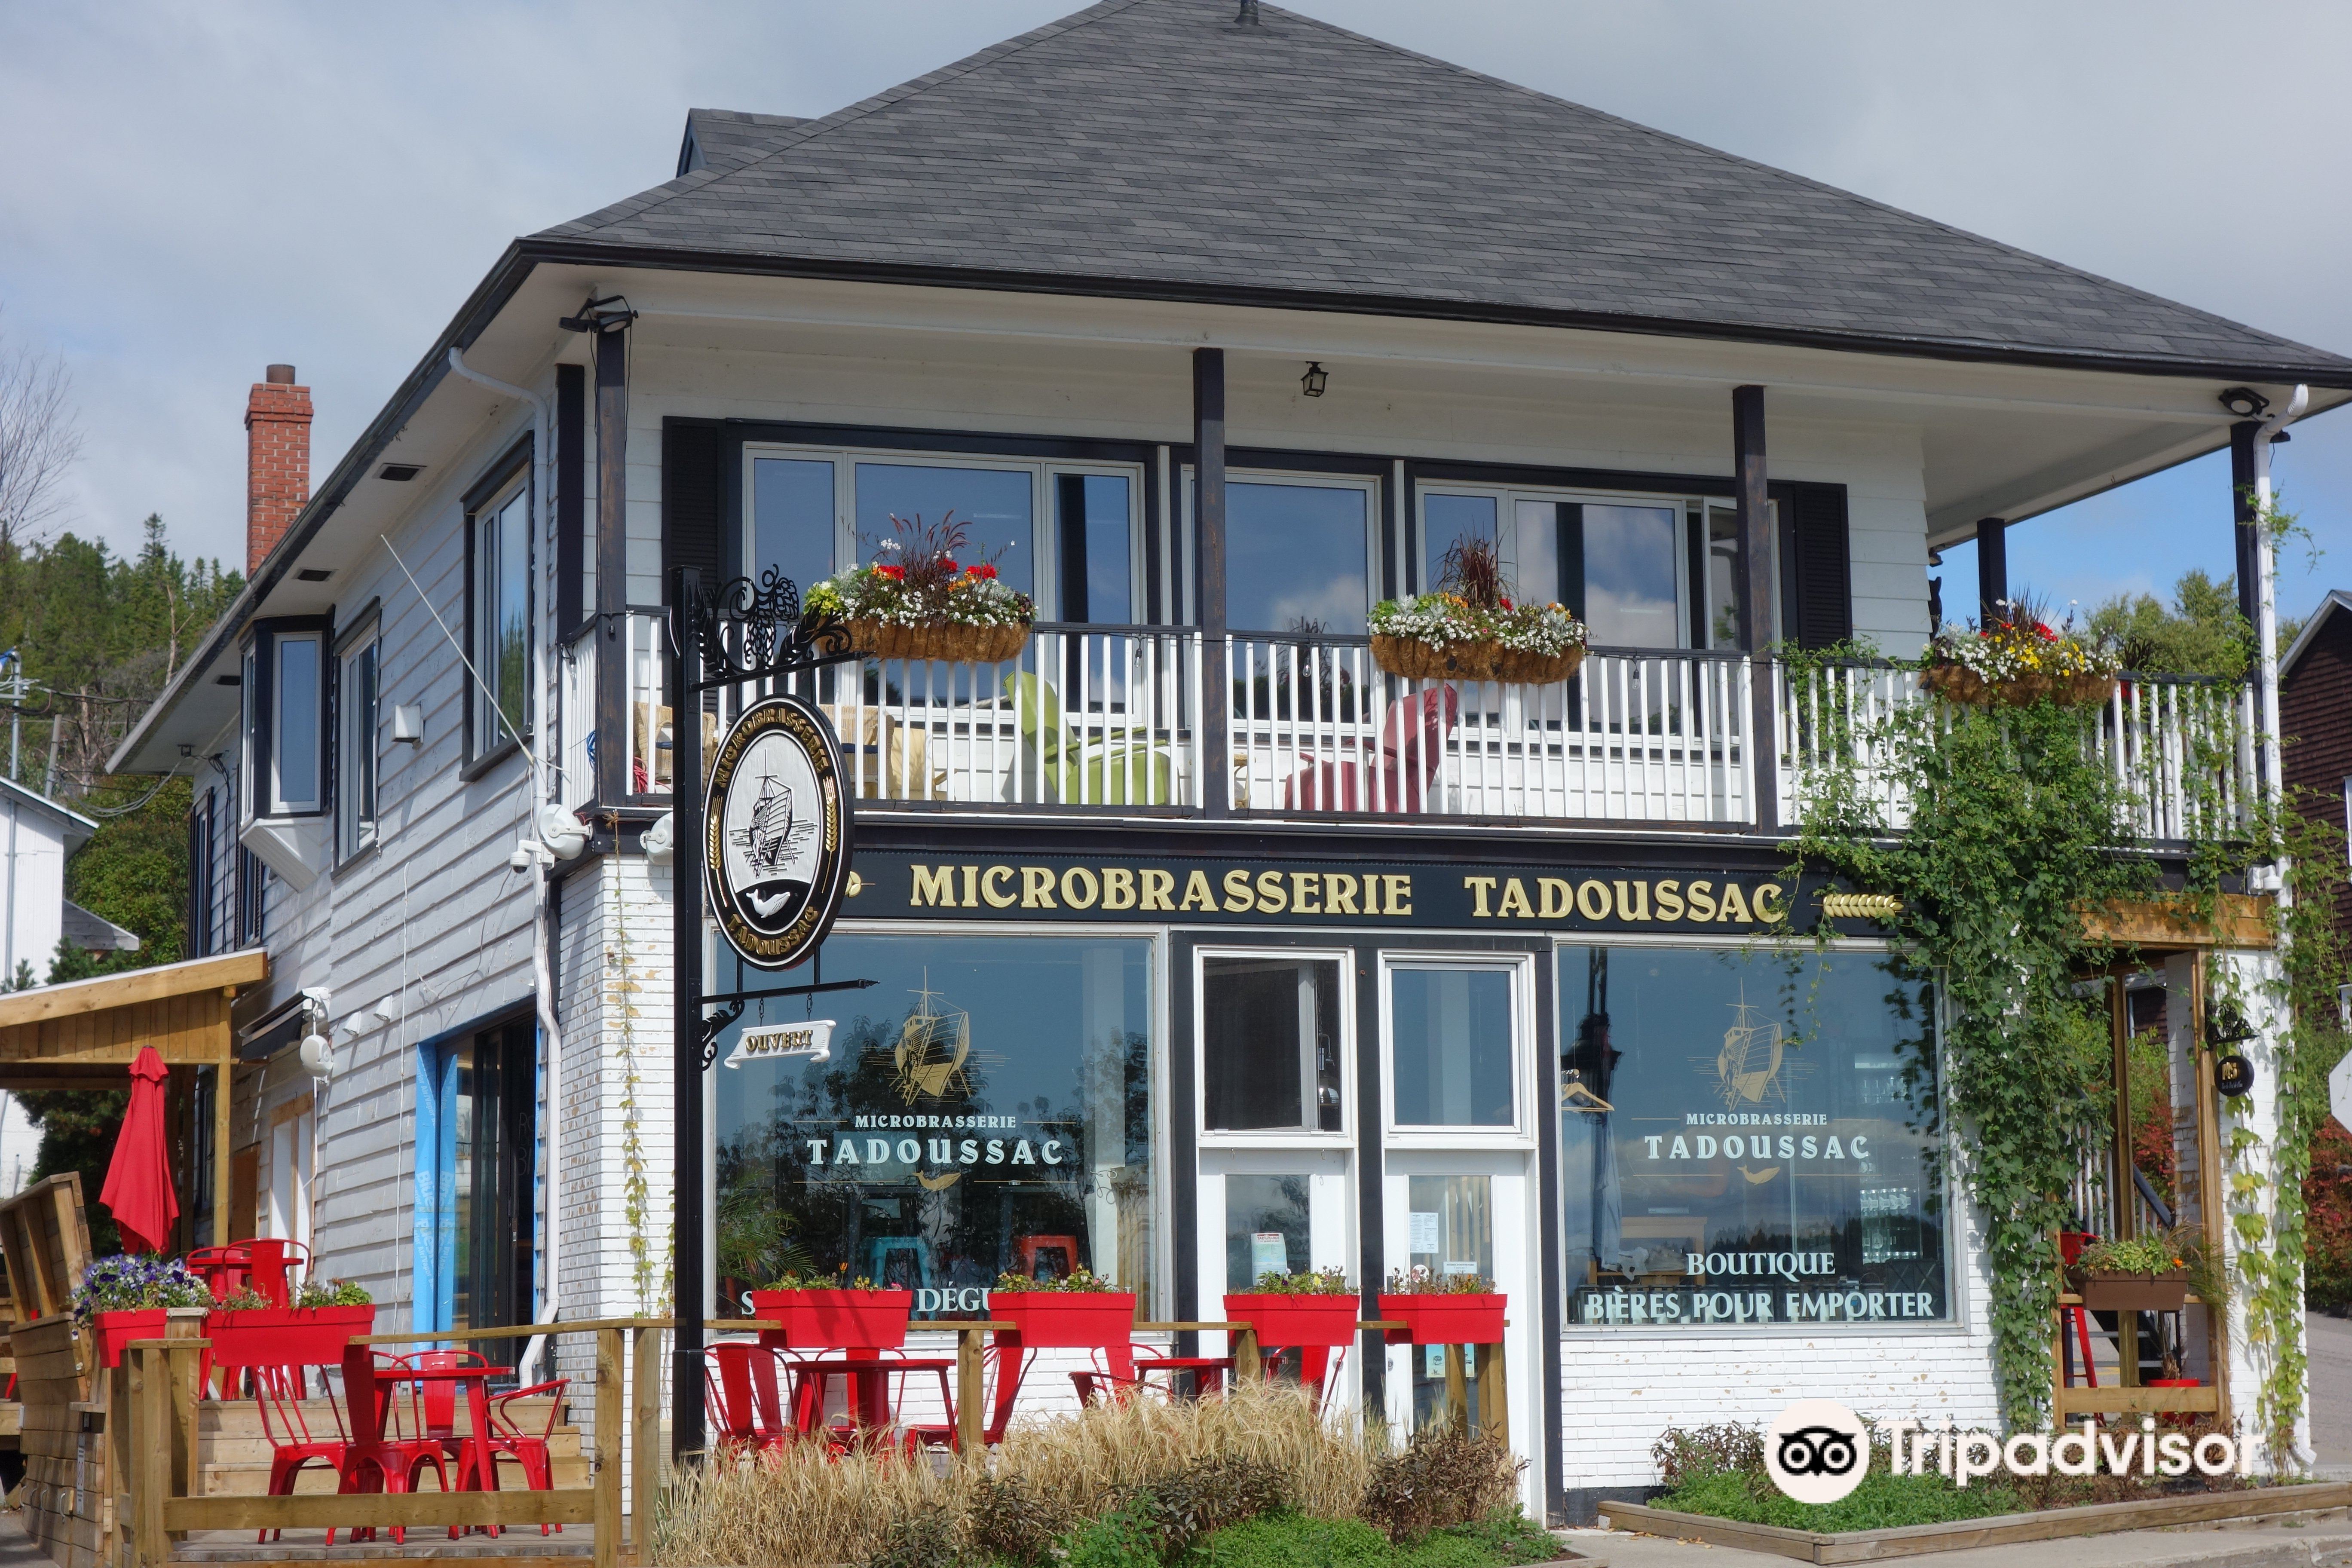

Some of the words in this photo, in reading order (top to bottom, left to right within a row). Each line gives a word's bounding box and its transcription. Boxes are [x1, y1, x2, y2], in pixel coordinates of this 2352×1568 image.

[714, 707, 829, 788] MICROBRASSERIE
[910, 865, 1412, 916] MICROBRASSERIE
[1464, 876, 1783, 923] TADOUSSAC
[727, 906, 819, 956] TADOUSSAC
[746, 1029, 813, 1052] OUVERT
[855, 1115, 1016, 1128] MICROBRASSERIE
[1686, 1113, 1827, 1125] MICROBRASSERIE
[807, 1139, 1063, 1165] TADOUSSAC
[1645, 1135, 1869, 1159] TADOUSSAC
[1687, 1252, 1835, 1282] BOUTIQUE
[1588, 1285, 1679, 1319] BIÈRES
[1694, 1292, 1773, 1318] POUR
[1786, 1292, 1934, 1317] EMPORTER
